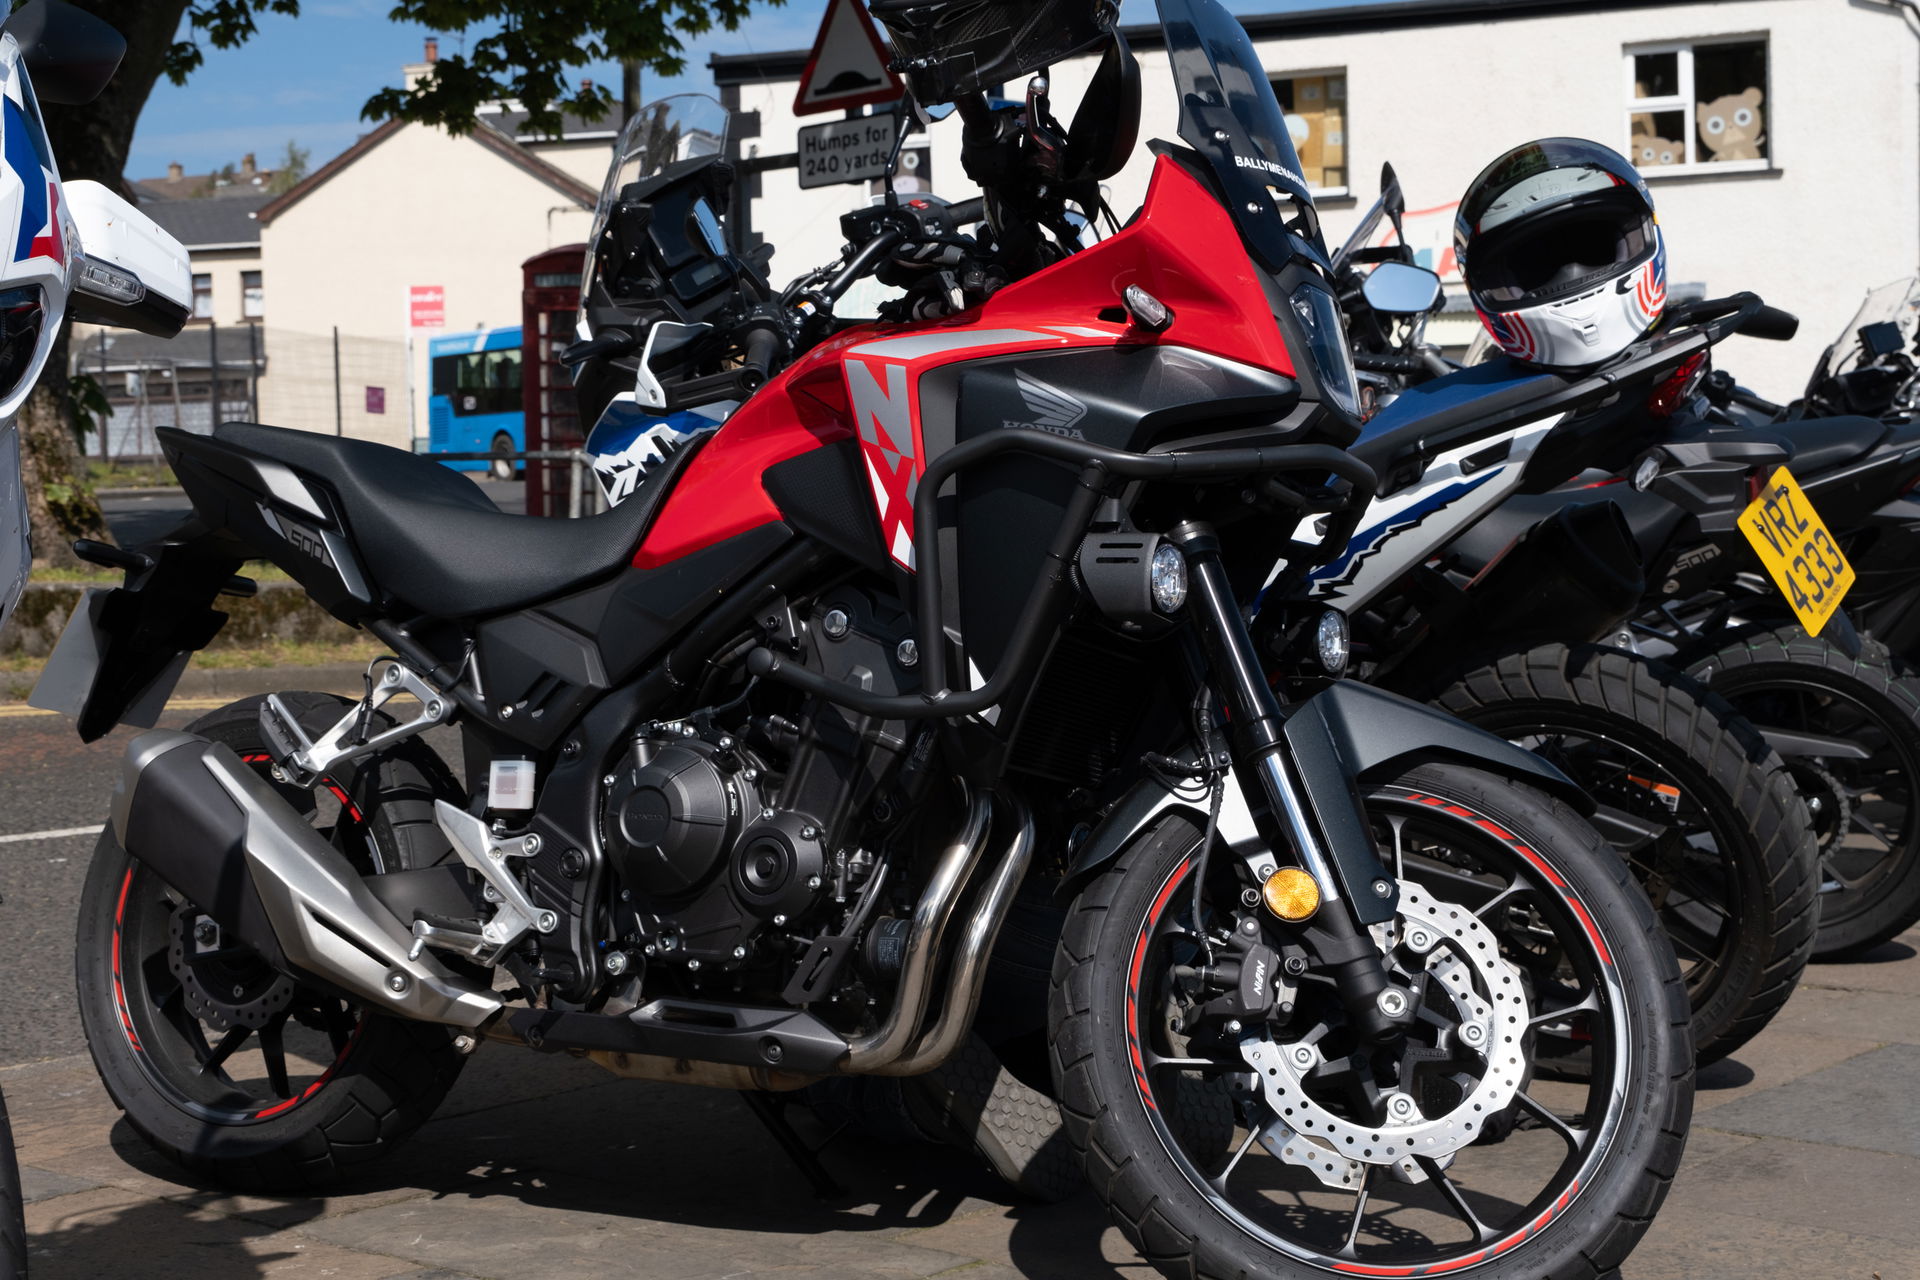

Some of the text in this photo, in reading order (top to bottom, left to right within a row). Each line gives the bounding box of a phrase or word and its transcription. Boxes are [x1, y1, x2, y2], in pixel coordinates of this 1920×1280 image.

[805, 126, 888, 153] Humps for
[806, 148, 888, 176] 240 yards
[1752, 484, 1809, 558] VRZ
[291, 529, 324, 562] 500
[1675, 549, 1717, 570] 500
[1785, 528, 1844, 614] 4333
